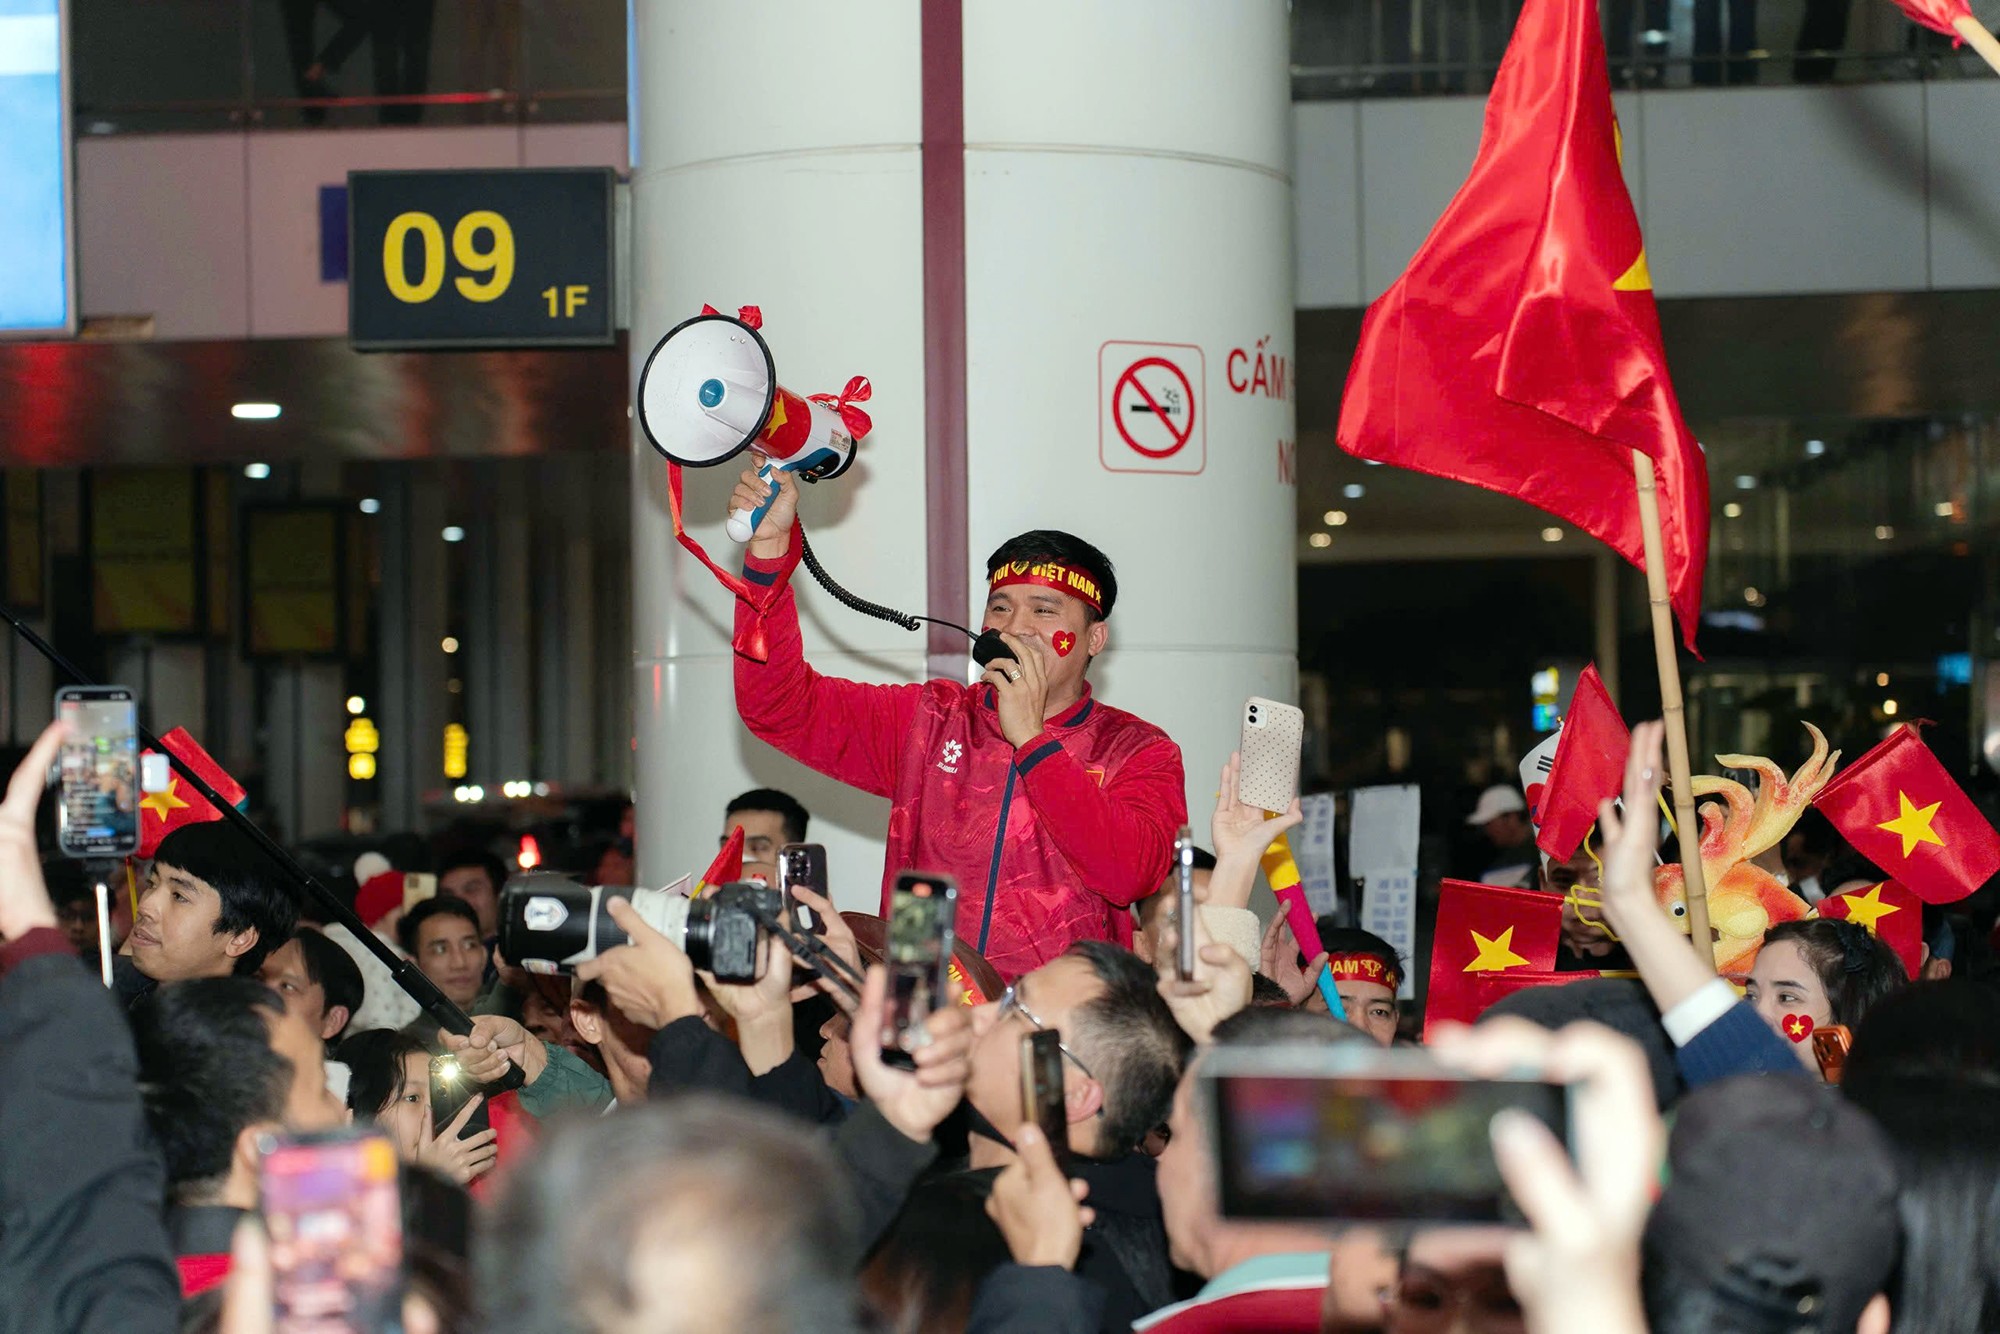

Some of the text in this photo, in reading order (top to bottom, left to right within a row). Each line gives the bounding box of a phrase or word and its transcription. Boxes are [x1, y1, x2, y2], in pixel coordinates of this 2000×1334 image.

[383, 210, 515, 304] 09
[541, 285, 590, 318] 1F
[1067, 570, 1096, 598] NAM
[1329, 960, 1358, 974] AM
